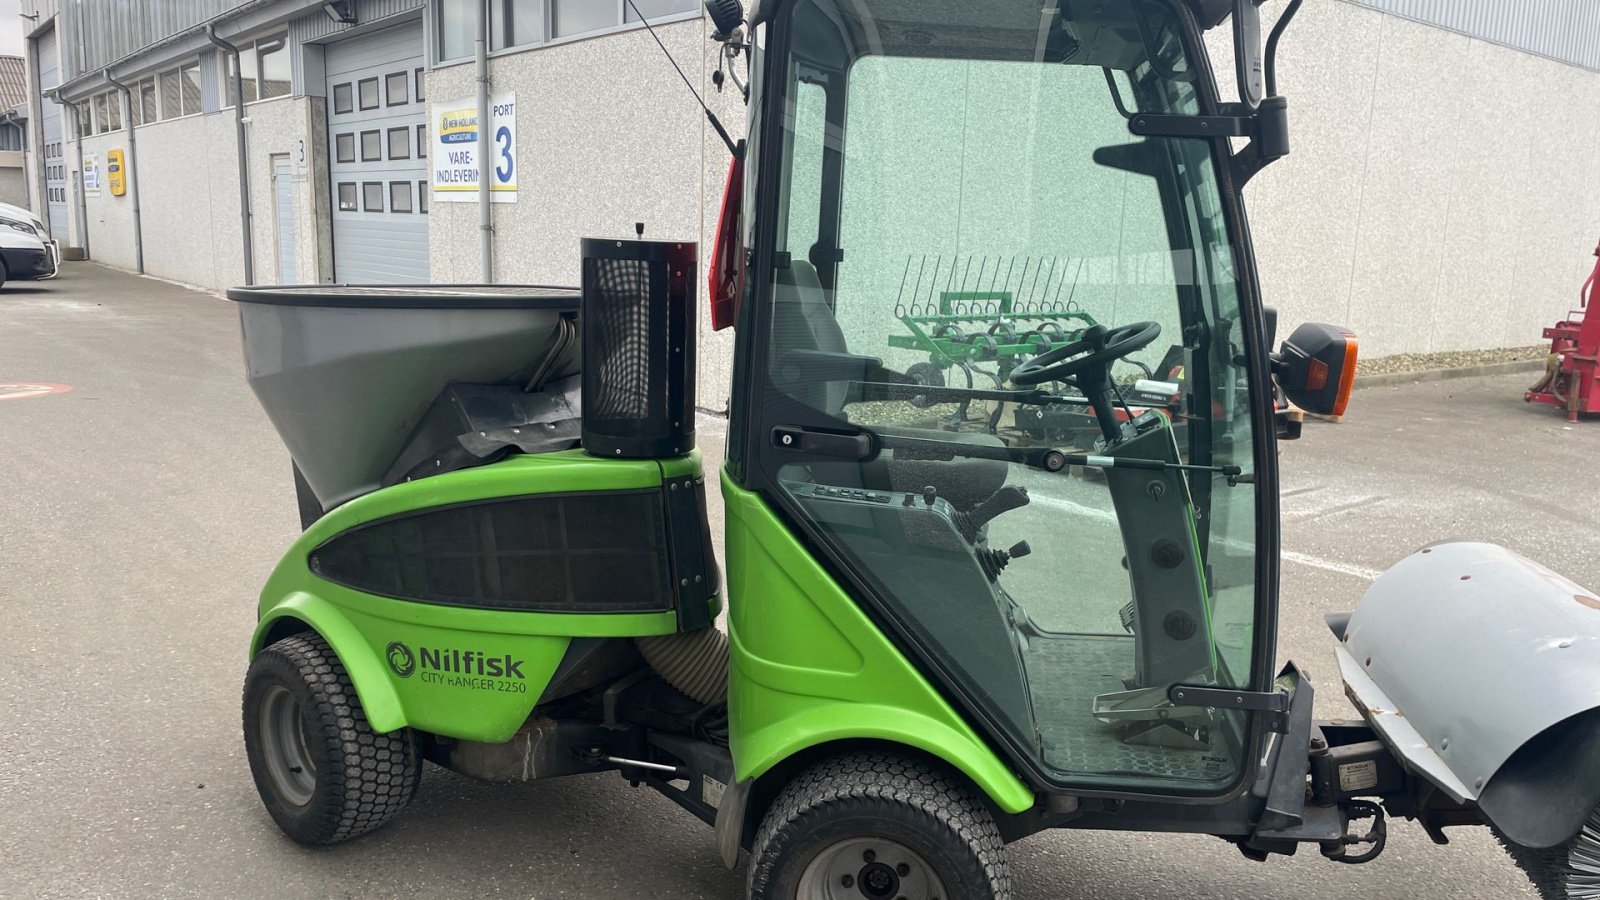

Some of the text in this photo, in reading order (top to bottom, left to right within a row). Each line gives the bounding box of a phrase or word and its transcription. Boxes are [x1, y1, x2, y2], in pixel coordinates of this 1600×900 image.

[493, 104, 514, 117] PORT
[448, 120, 458, 128] NEW
[299, 140, 304, 162] 3
[448, 151, 473, 165] VARE-
[496, 126, 513, 183] 3
[436, 169, 479, 183] INDLEVERIN
[419, 647, 526, 679] Nilfisk
[420, 671, 445, 685] CITY
[497, 680, 527, 694] 2250
